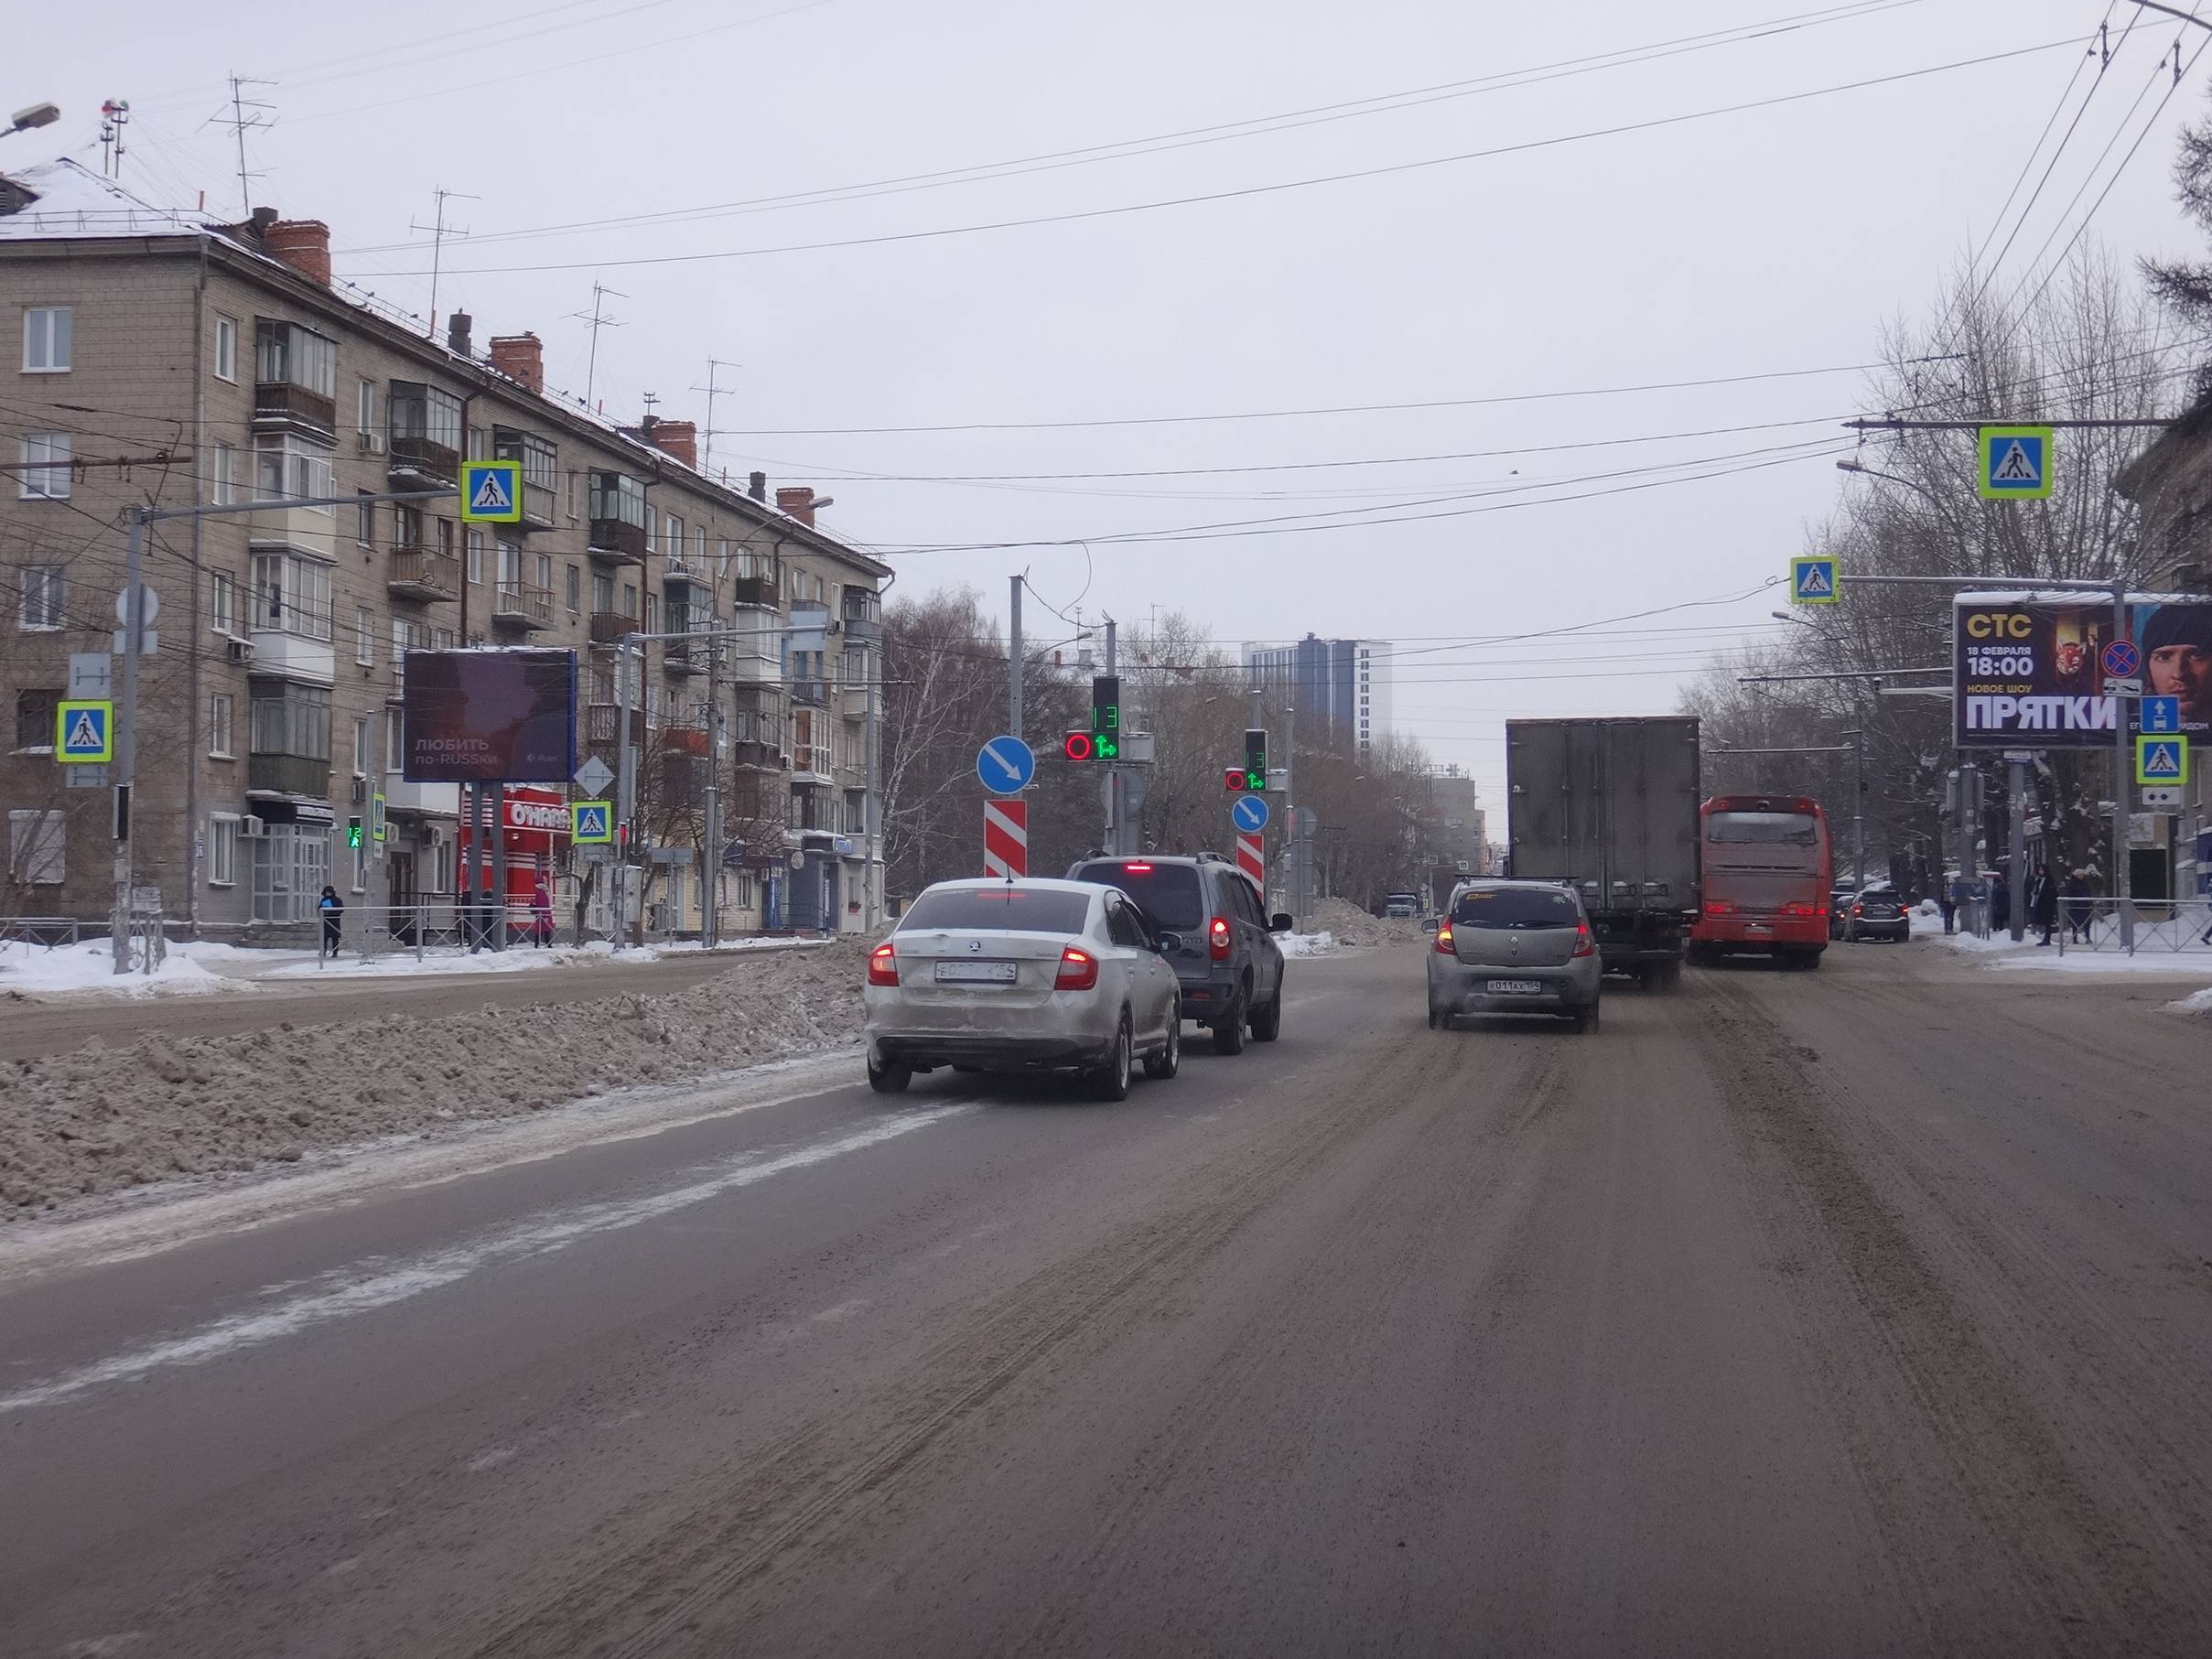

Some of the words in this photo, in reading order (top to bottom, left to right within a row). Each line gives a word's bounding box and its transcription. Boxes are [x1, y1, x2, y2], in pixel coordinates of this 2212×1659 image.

[1967, 614, 2033, 638] СТС
[1968, 647, 1979, 655] 18
[1981, 646, 2031, 656] ФЕВРАЛЯ
[1968, 657, 2034, 675] 18:00
[1967, 685, 2003, 694] НОВОЕ
[2007, 684, 2033, 694] ШОУ
[1967, 696, 2117, 729] ПРЯТКИ
[415, 738, 490, 751] ЛЮБИТЬ
[415, 753, 498, 765] по-RUSSки
